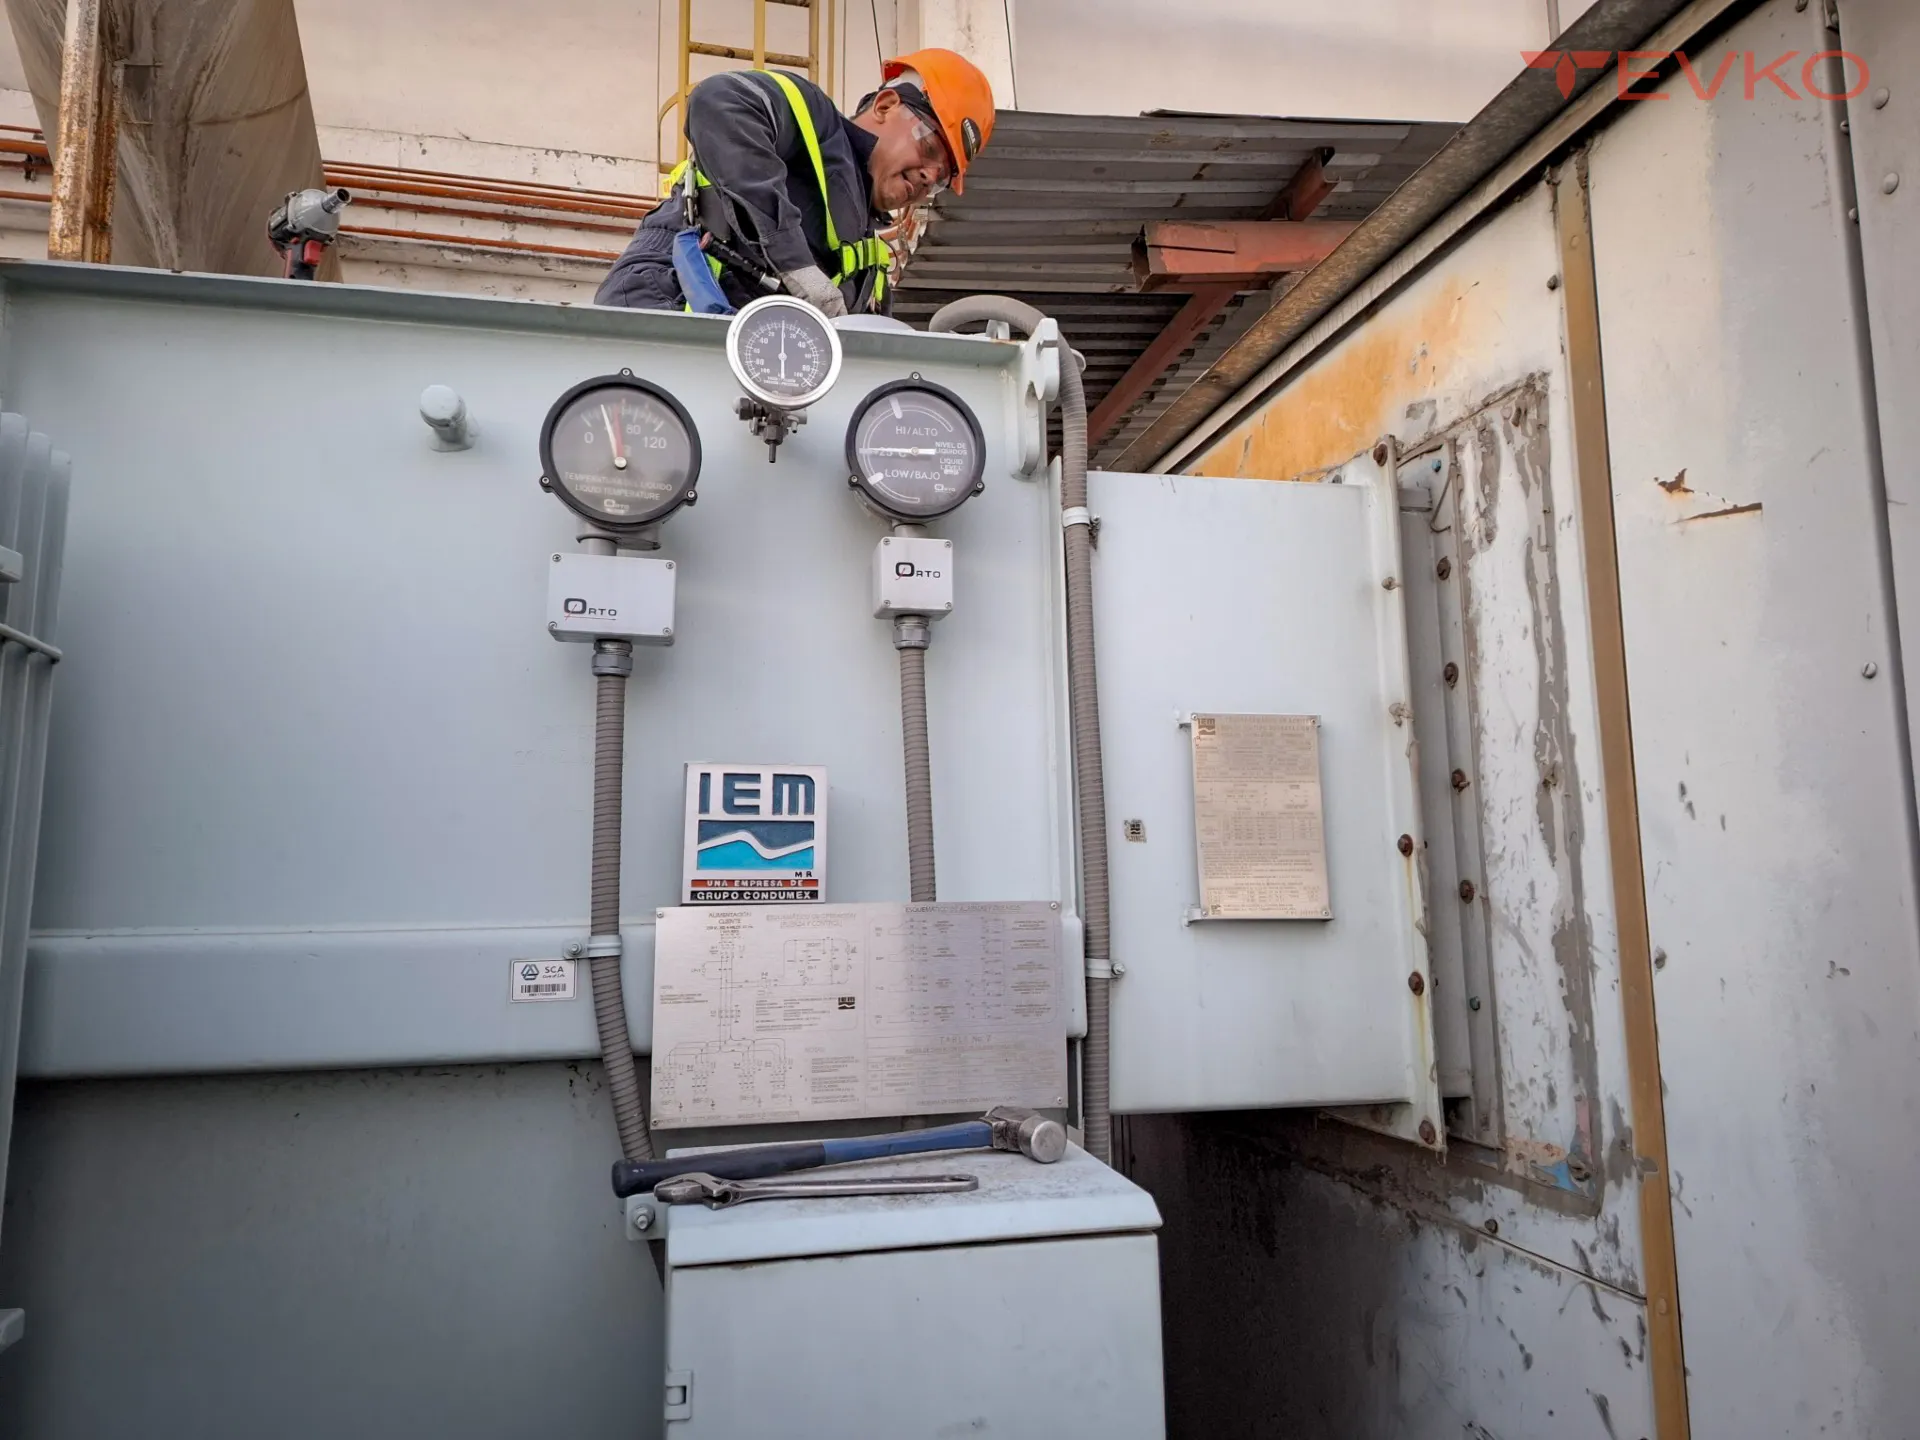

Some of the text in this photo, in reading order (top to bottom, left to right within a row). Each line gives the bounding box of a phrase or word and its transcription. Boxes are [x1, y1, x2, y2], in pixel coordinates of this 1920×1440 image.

[895, 425, 938, 437] HI/ALTO
[584, 431, 594, 444] 0
[643, 436, 667, 449] 120
[884, 468, 941, 480] LOW/BAJO
[575, 484, 602, 493] LIQUID
[895, 562, 941, 579] ORTO
[564, 598, 617, 617] ORTO
[699, 773, 815, 815] IEM
[790, 879, 803, 887] DE
[697, 890, 811, 900] GRUPO CONDUMEX
[545, 966, 564, 974] SCA
